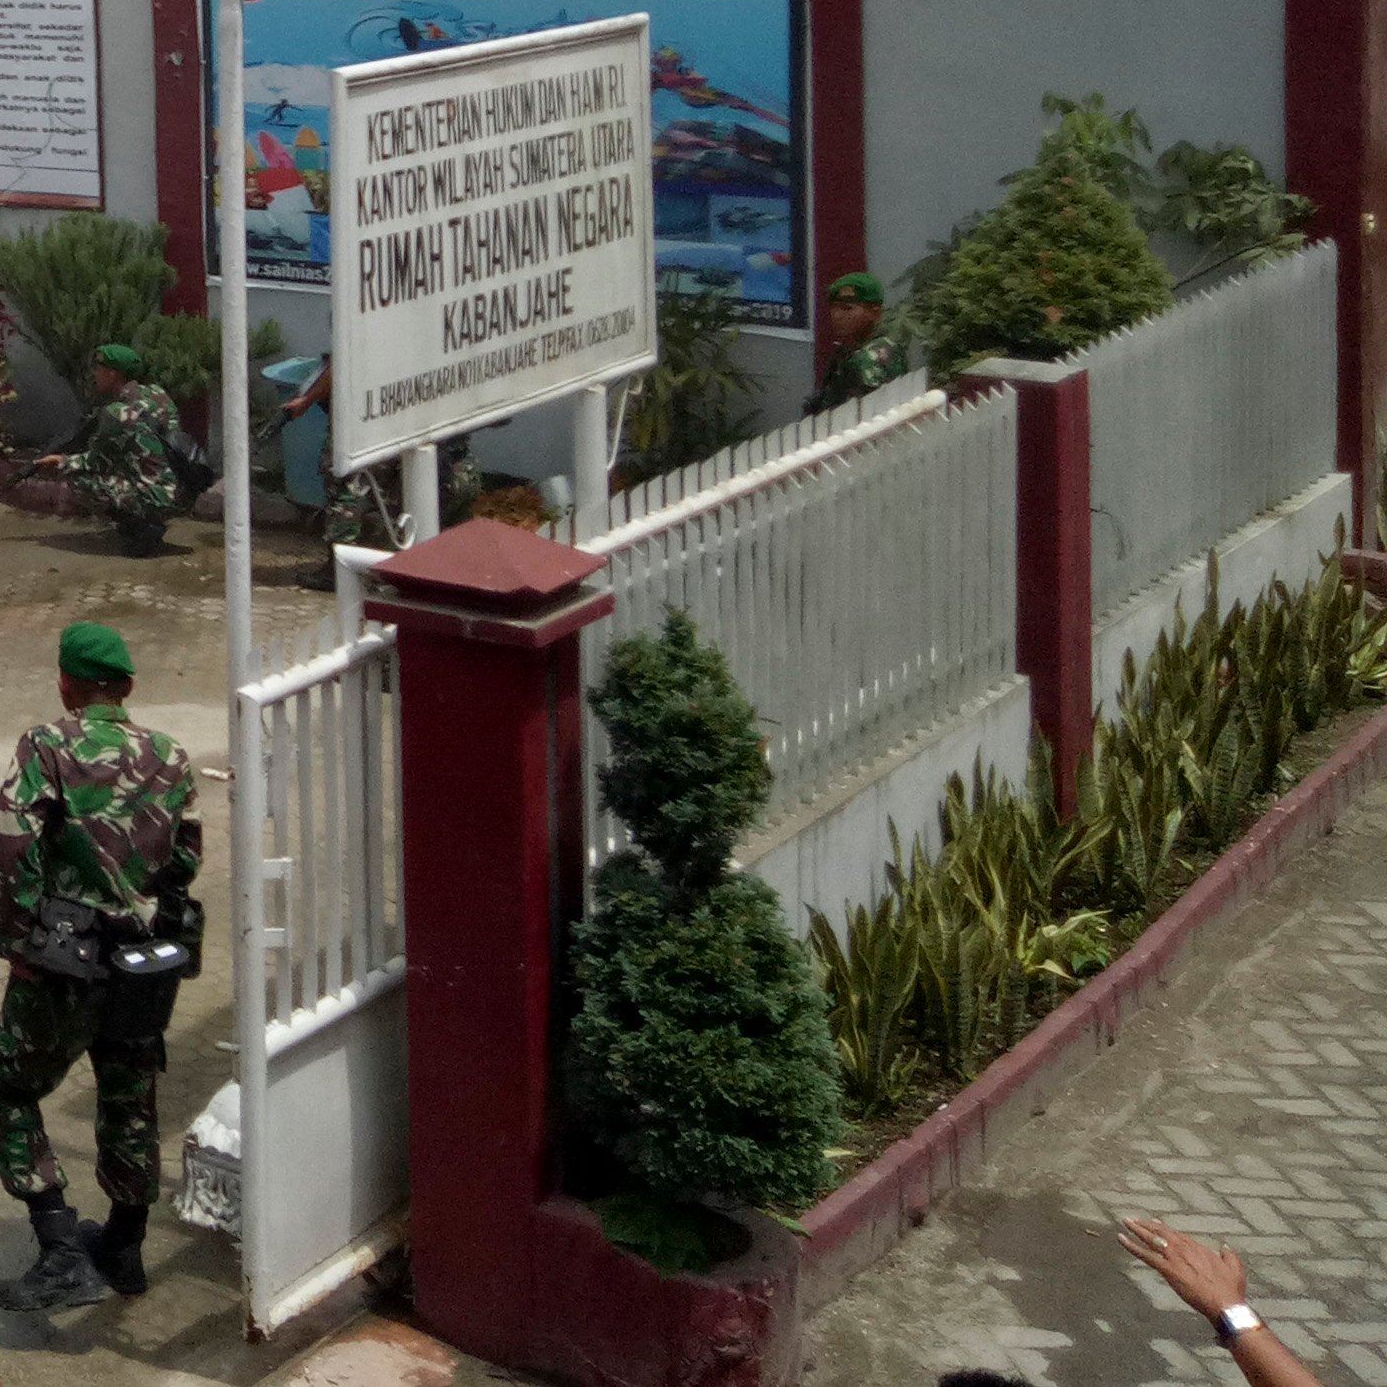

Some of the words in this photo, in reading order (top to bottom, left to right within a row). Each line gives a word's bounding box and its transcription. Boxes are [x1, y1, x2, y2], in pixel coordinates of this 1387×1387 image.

[367, 94, 482, 164] KEMENTERIAN
[486, 80, 536, 135] HUKUM
[538, 75, 566, 126] DAN
[570, 68, 605, 118] HAM
[357, 164, 428, 227] KANTOR
[431, 147, 505, 211] WILAYAH
[509, 130, 588, 190] SUMATERA
[591, 117, 635, 169] UTARA
[359, 220, 445, 313] RUMAH
[448, 193, 549, 288] TAHANAN
[556, 173, 635, 256] NEGARA
[443, 267, 575, 354] KABANJAHE
